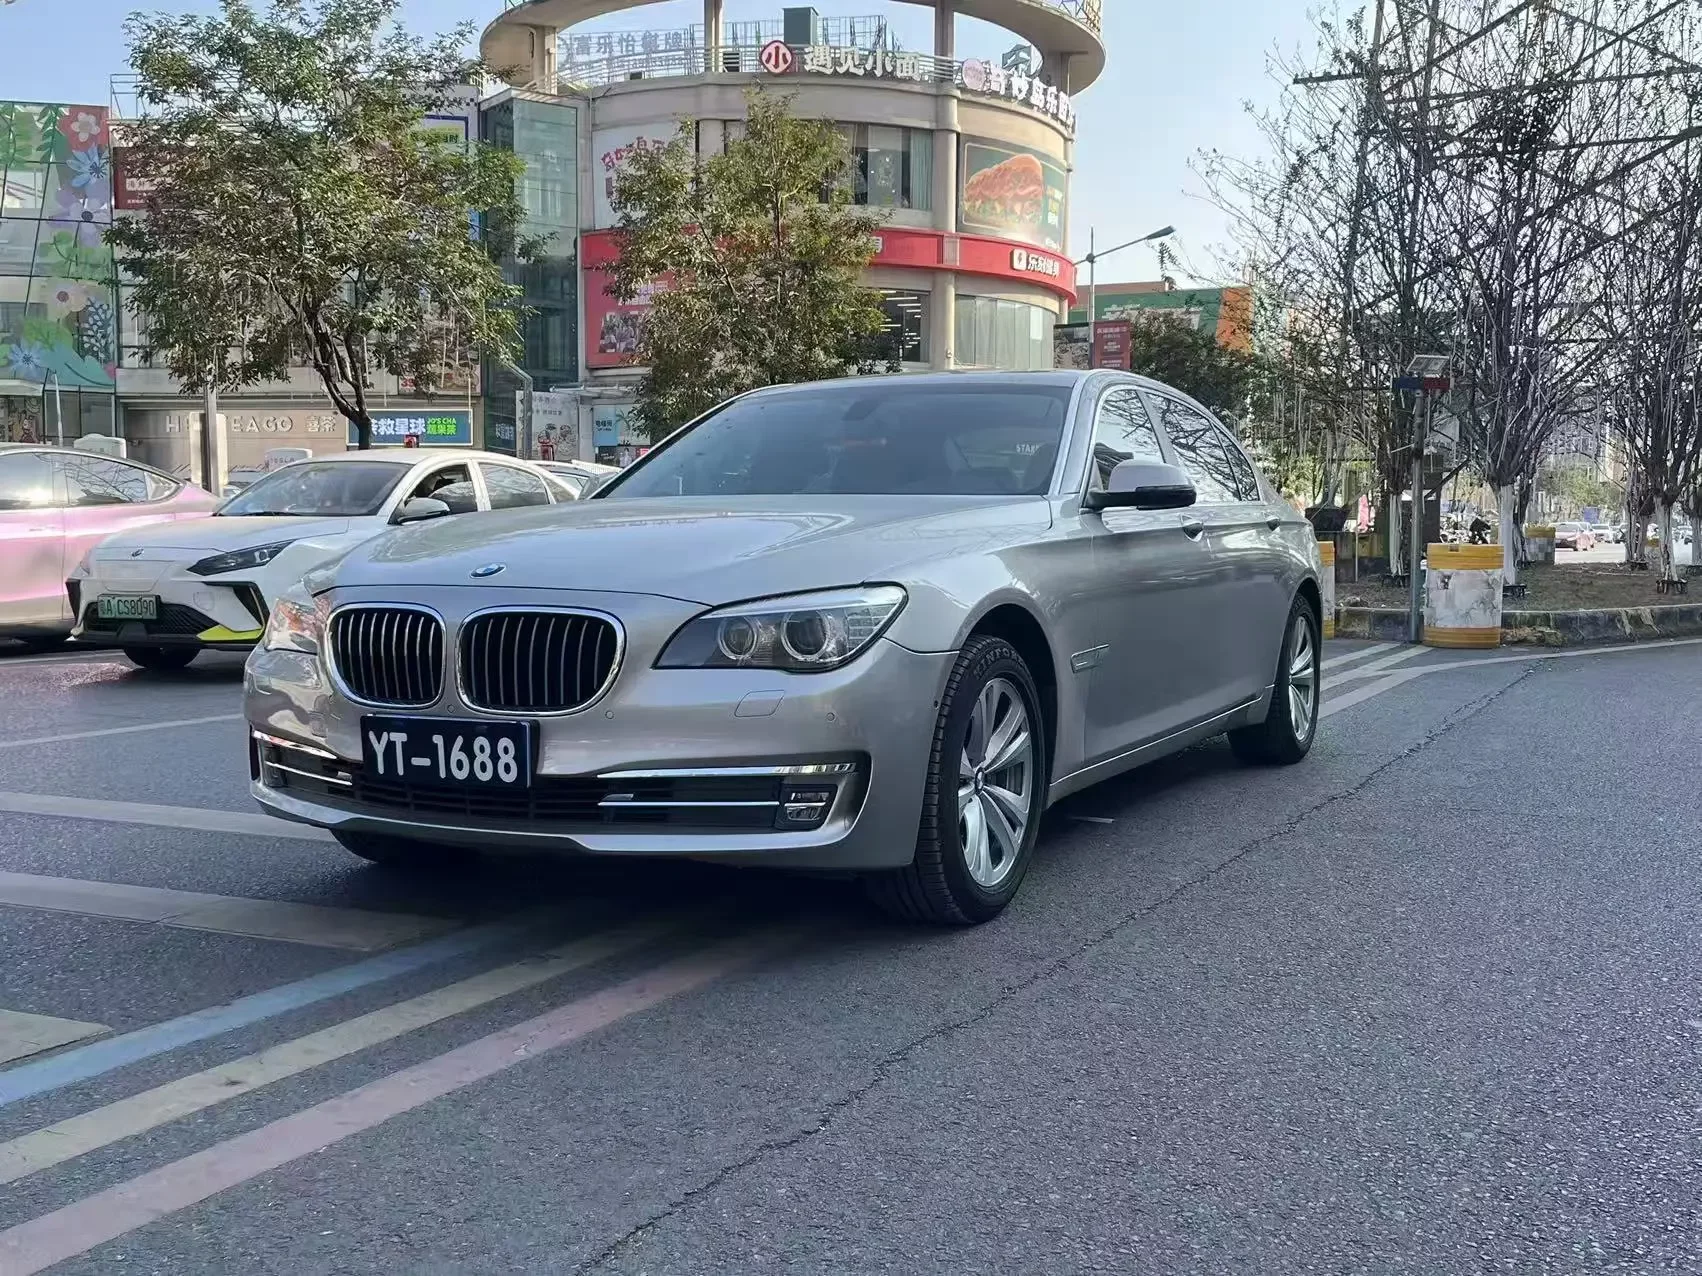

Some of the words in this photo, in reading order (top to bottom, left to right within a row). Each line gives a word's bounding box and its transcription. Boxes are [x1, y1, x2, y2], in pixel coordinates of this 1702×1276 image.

[803, 45, 922, 82] 遇见小面
[442, 417, 456, 425] CHA
[117, 599, 155, 616] CS8090
[368, 730, 518, 783] YT-1688
